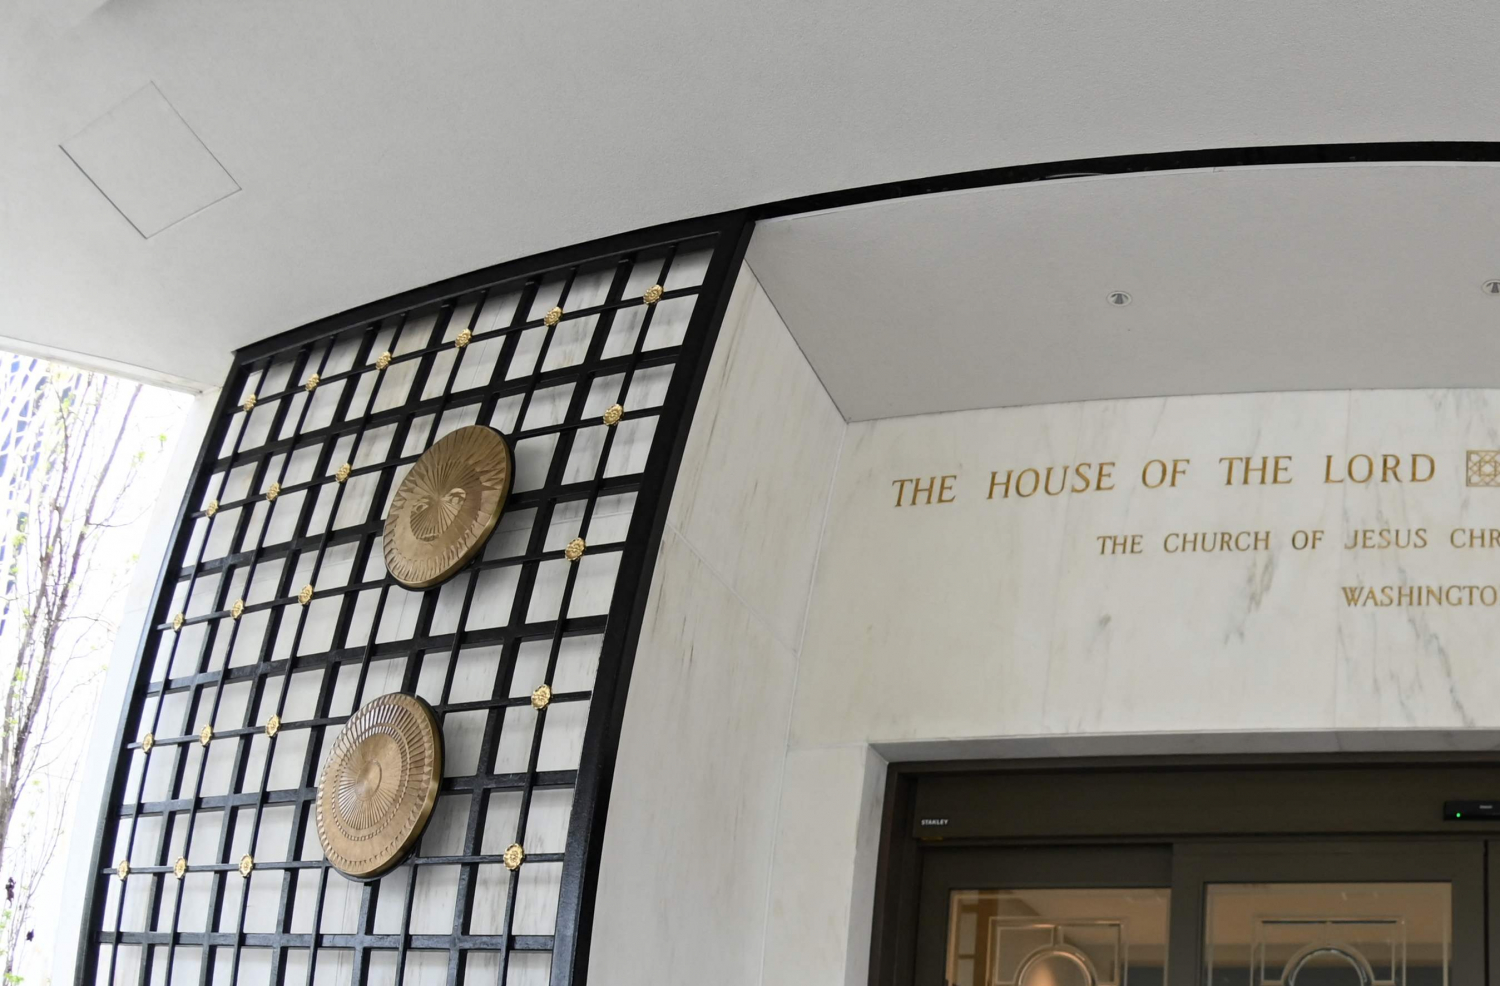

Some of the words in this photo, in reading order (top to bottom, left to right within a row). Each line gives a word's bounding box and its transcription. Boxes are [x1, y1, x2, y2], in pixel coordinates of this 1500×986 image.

[892, 474, 957, 508] THE
[986, 461, 1116, 500] HOUSE
[1141, 459, 1191, 489] OF
[1219, 455, 1293, 486] THE
[1324, 453, 1437, 485] LORD
[1097, 534, 1144, 555] THE
[1163, 530, 1271, 554] CHURCH
[1291, 529, 1325, 552] OF
[1344, 528, 1428, 550] JESUS
